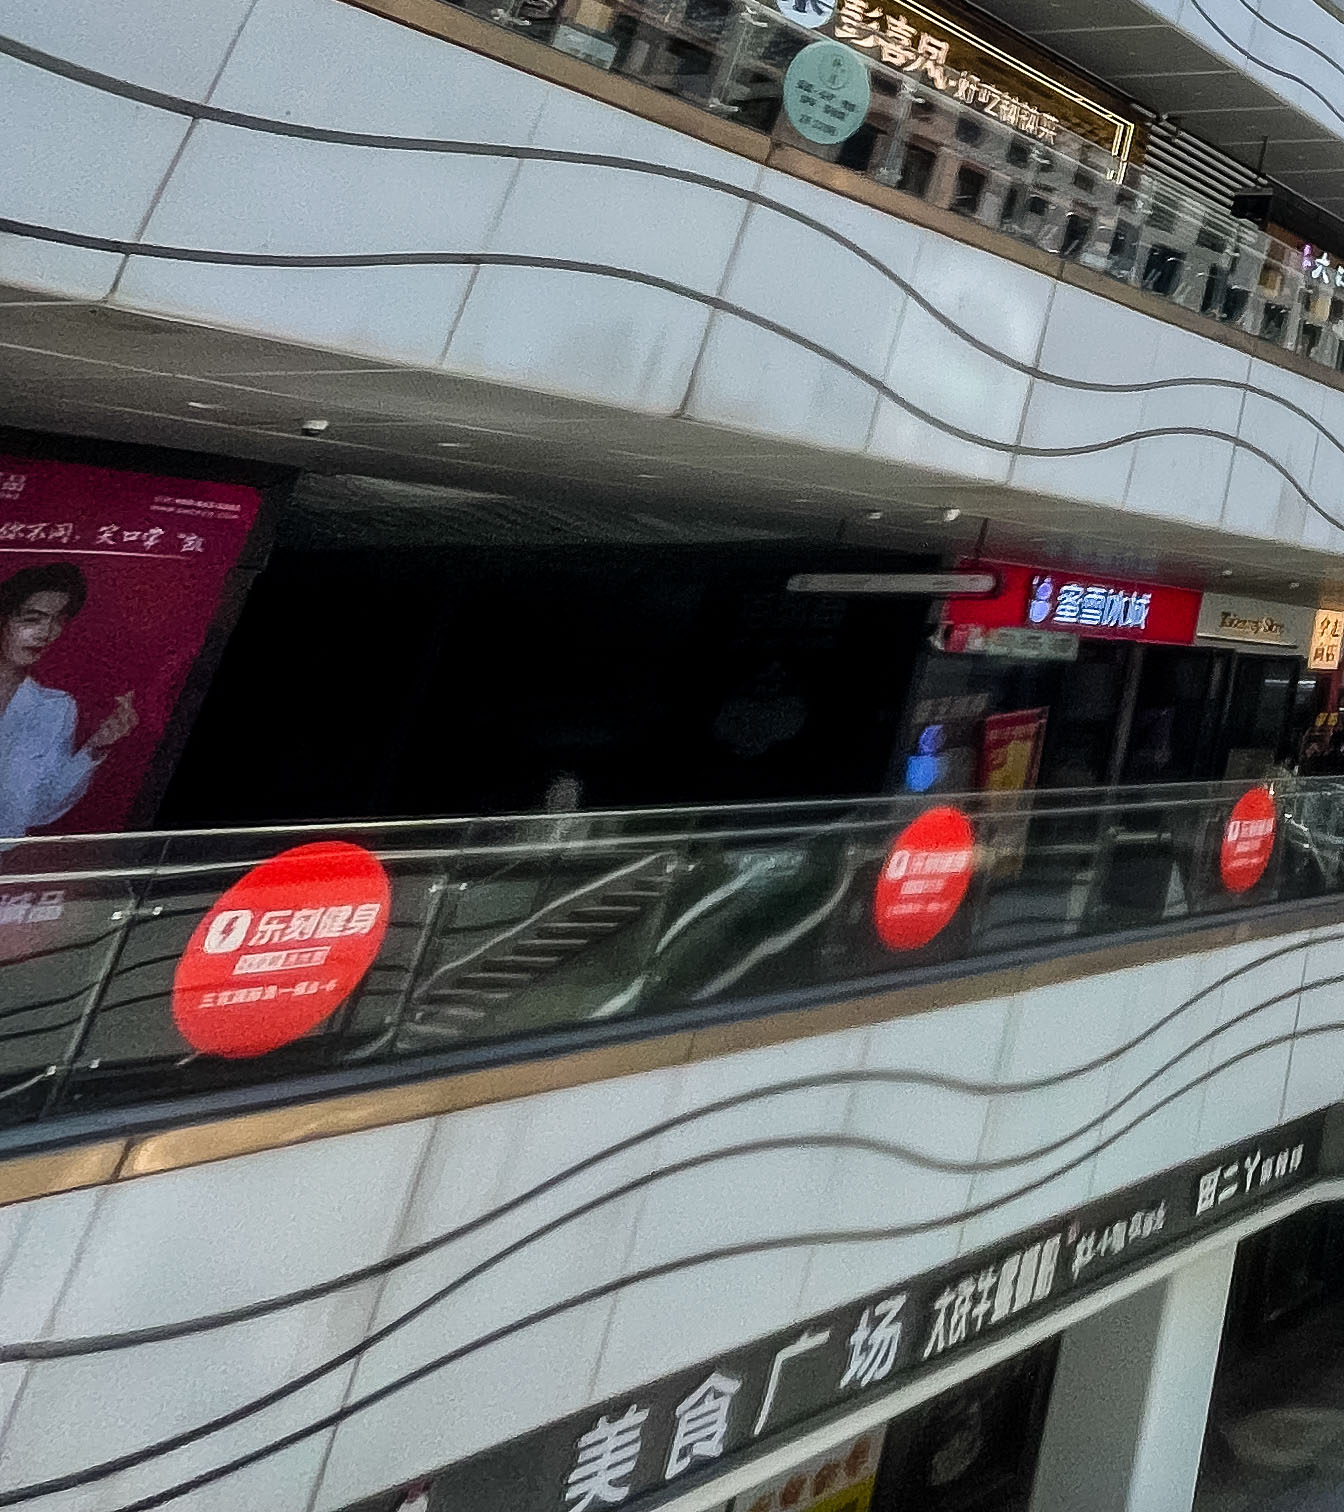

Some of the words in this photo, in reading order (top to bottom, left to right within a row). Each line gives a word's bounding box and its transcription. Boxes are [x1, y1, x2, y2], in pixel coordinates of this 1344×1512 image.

[1053, 583, 1152, 630] 蜜雪冰城
[247, 902, 382, 947] 乐刻健身
[563, 1294, 909, 1512] 美食广场
